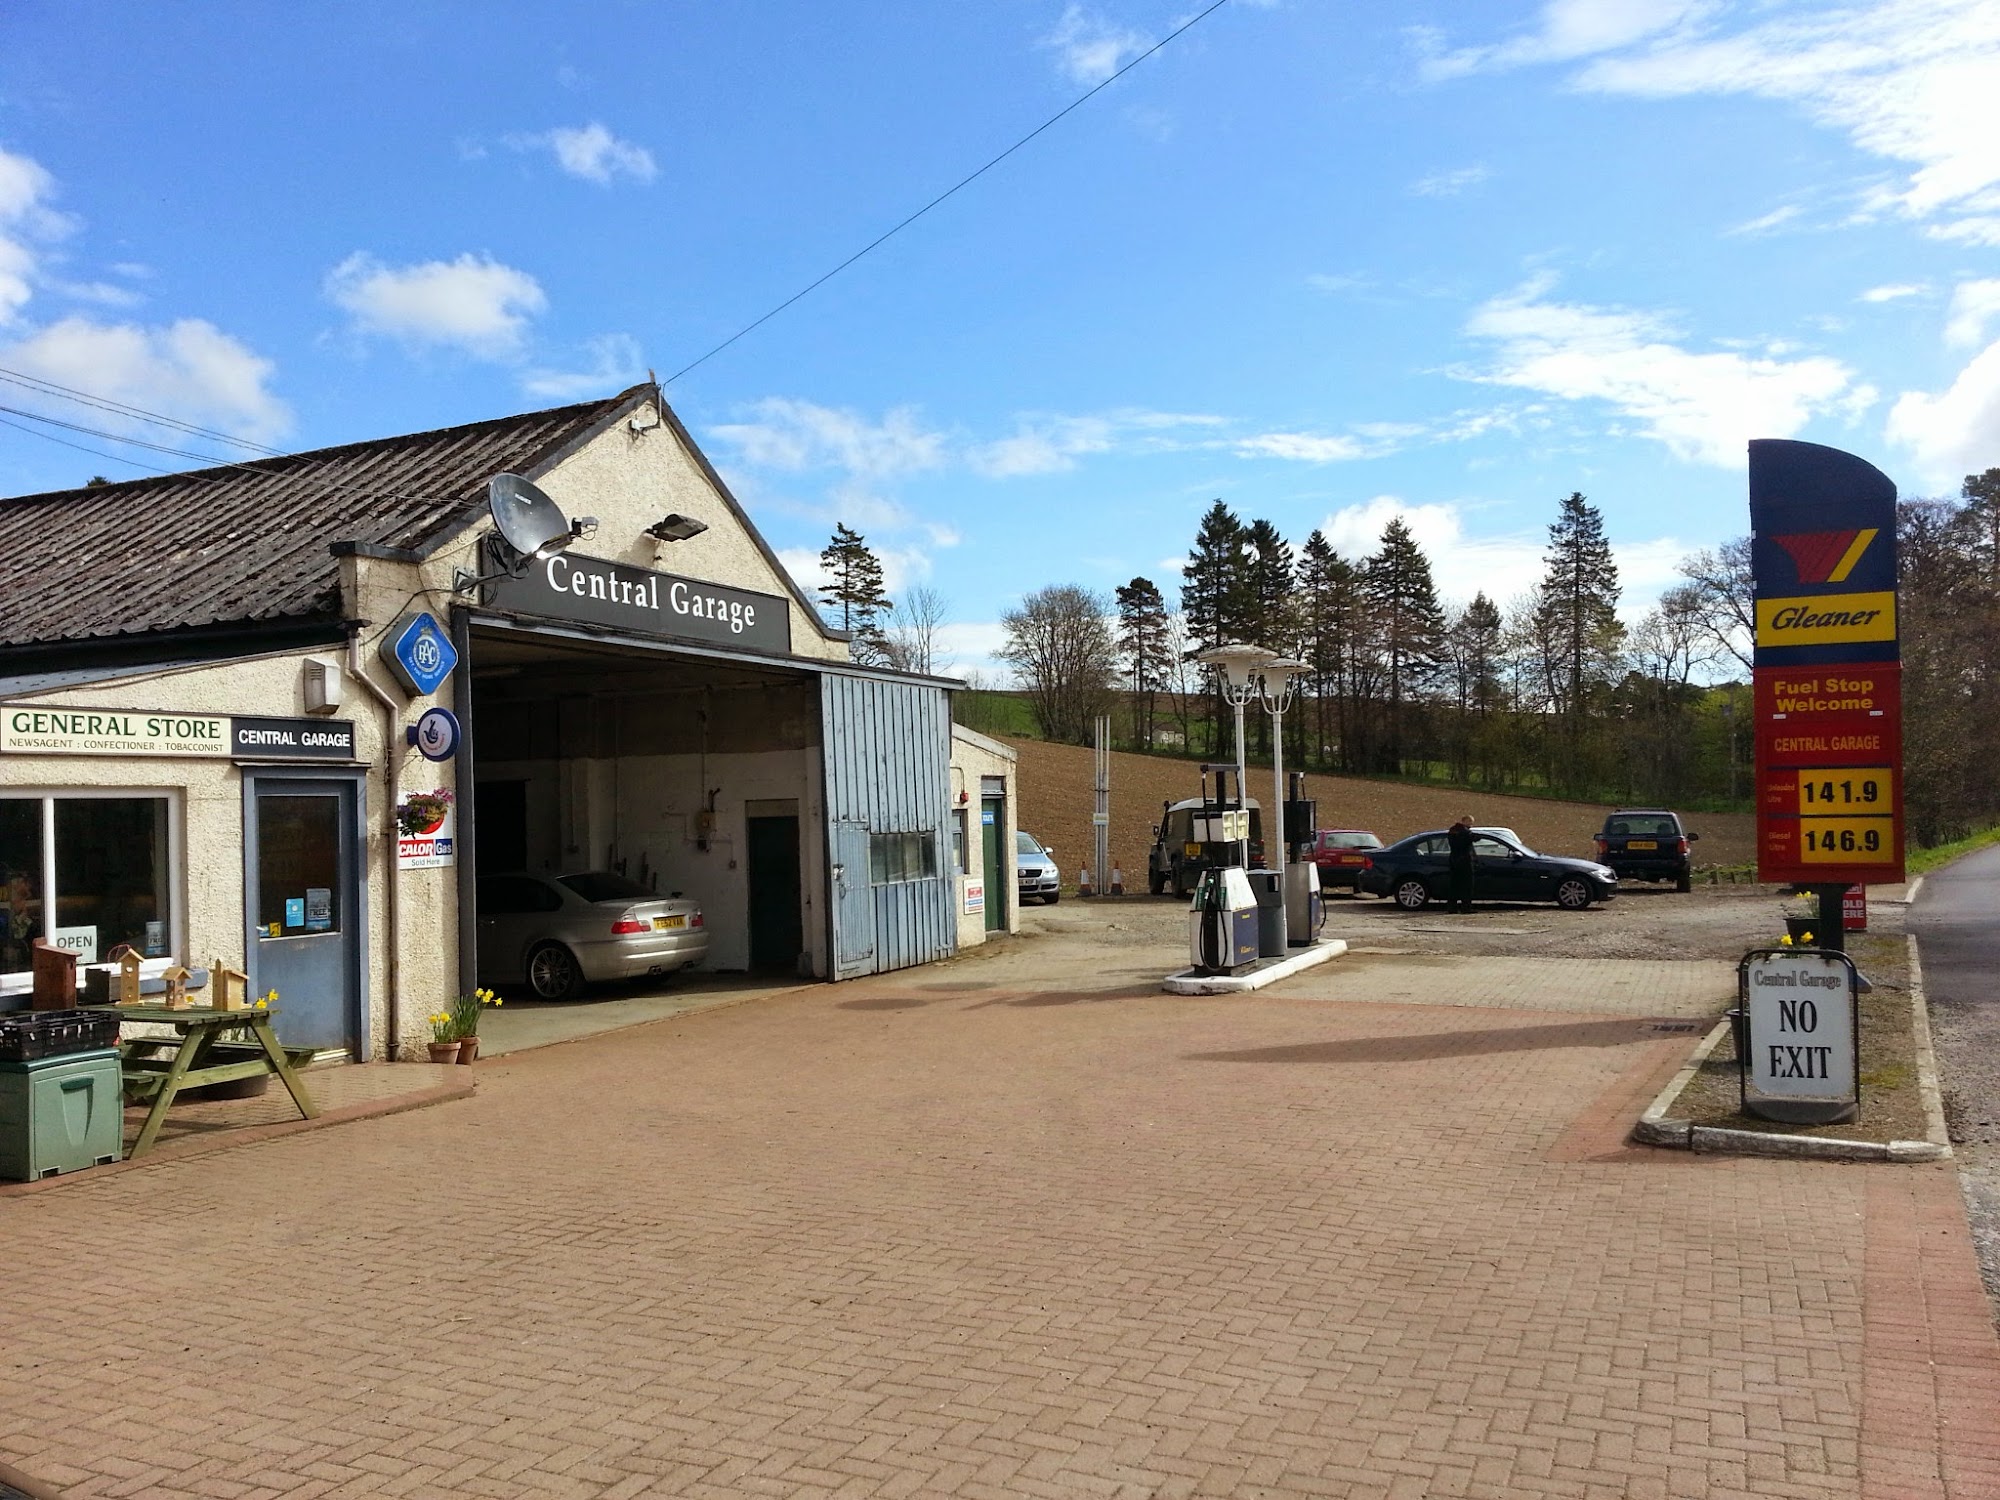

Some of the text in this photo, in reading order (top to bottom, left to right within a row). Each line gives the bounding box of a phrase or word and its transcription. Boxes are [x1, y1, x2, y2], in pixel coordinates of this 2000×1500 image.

[546, 556, 755, 634] Central Garage
[1771, 606, 1881, 631] Gleaner
[419, 640, 436, 665] RAC
[1774, 678, 1874, 695] Fuel Stop
[1776, 698, 1873, 713] Welcome
[12, 712, 221, 739] GENERAL STORE
[9, 738, 73, 749] NEWSAGENT
[84, 740, 155, 750] CONFECTIONER
[165, 742, 224, 752] TOBACCONIST
[238, 729, 350, 747] CENTRAL GARAGE
[1774, 735, 1880, 752] CENTRAL GARAGE
[1803, 781, 1878, 803] 141.9
[1769, 832, 1791, 840] Diesel
[1804, 829, 1880, 852] 146.9
[399, 842, 452, 857] CALOR Gas
[411, 859, 425, 867] Sold
[1842, 899, 1864, 909] OLD
[1842, 909, 1865, 919] ERE
[57, 936, 92, 949] OPEN
[1754, 969, 1842, 990] Central Garage
[1779, 1000, 1818, 1033] NO
[1768, 1045, 1832, 1079] EXIT
